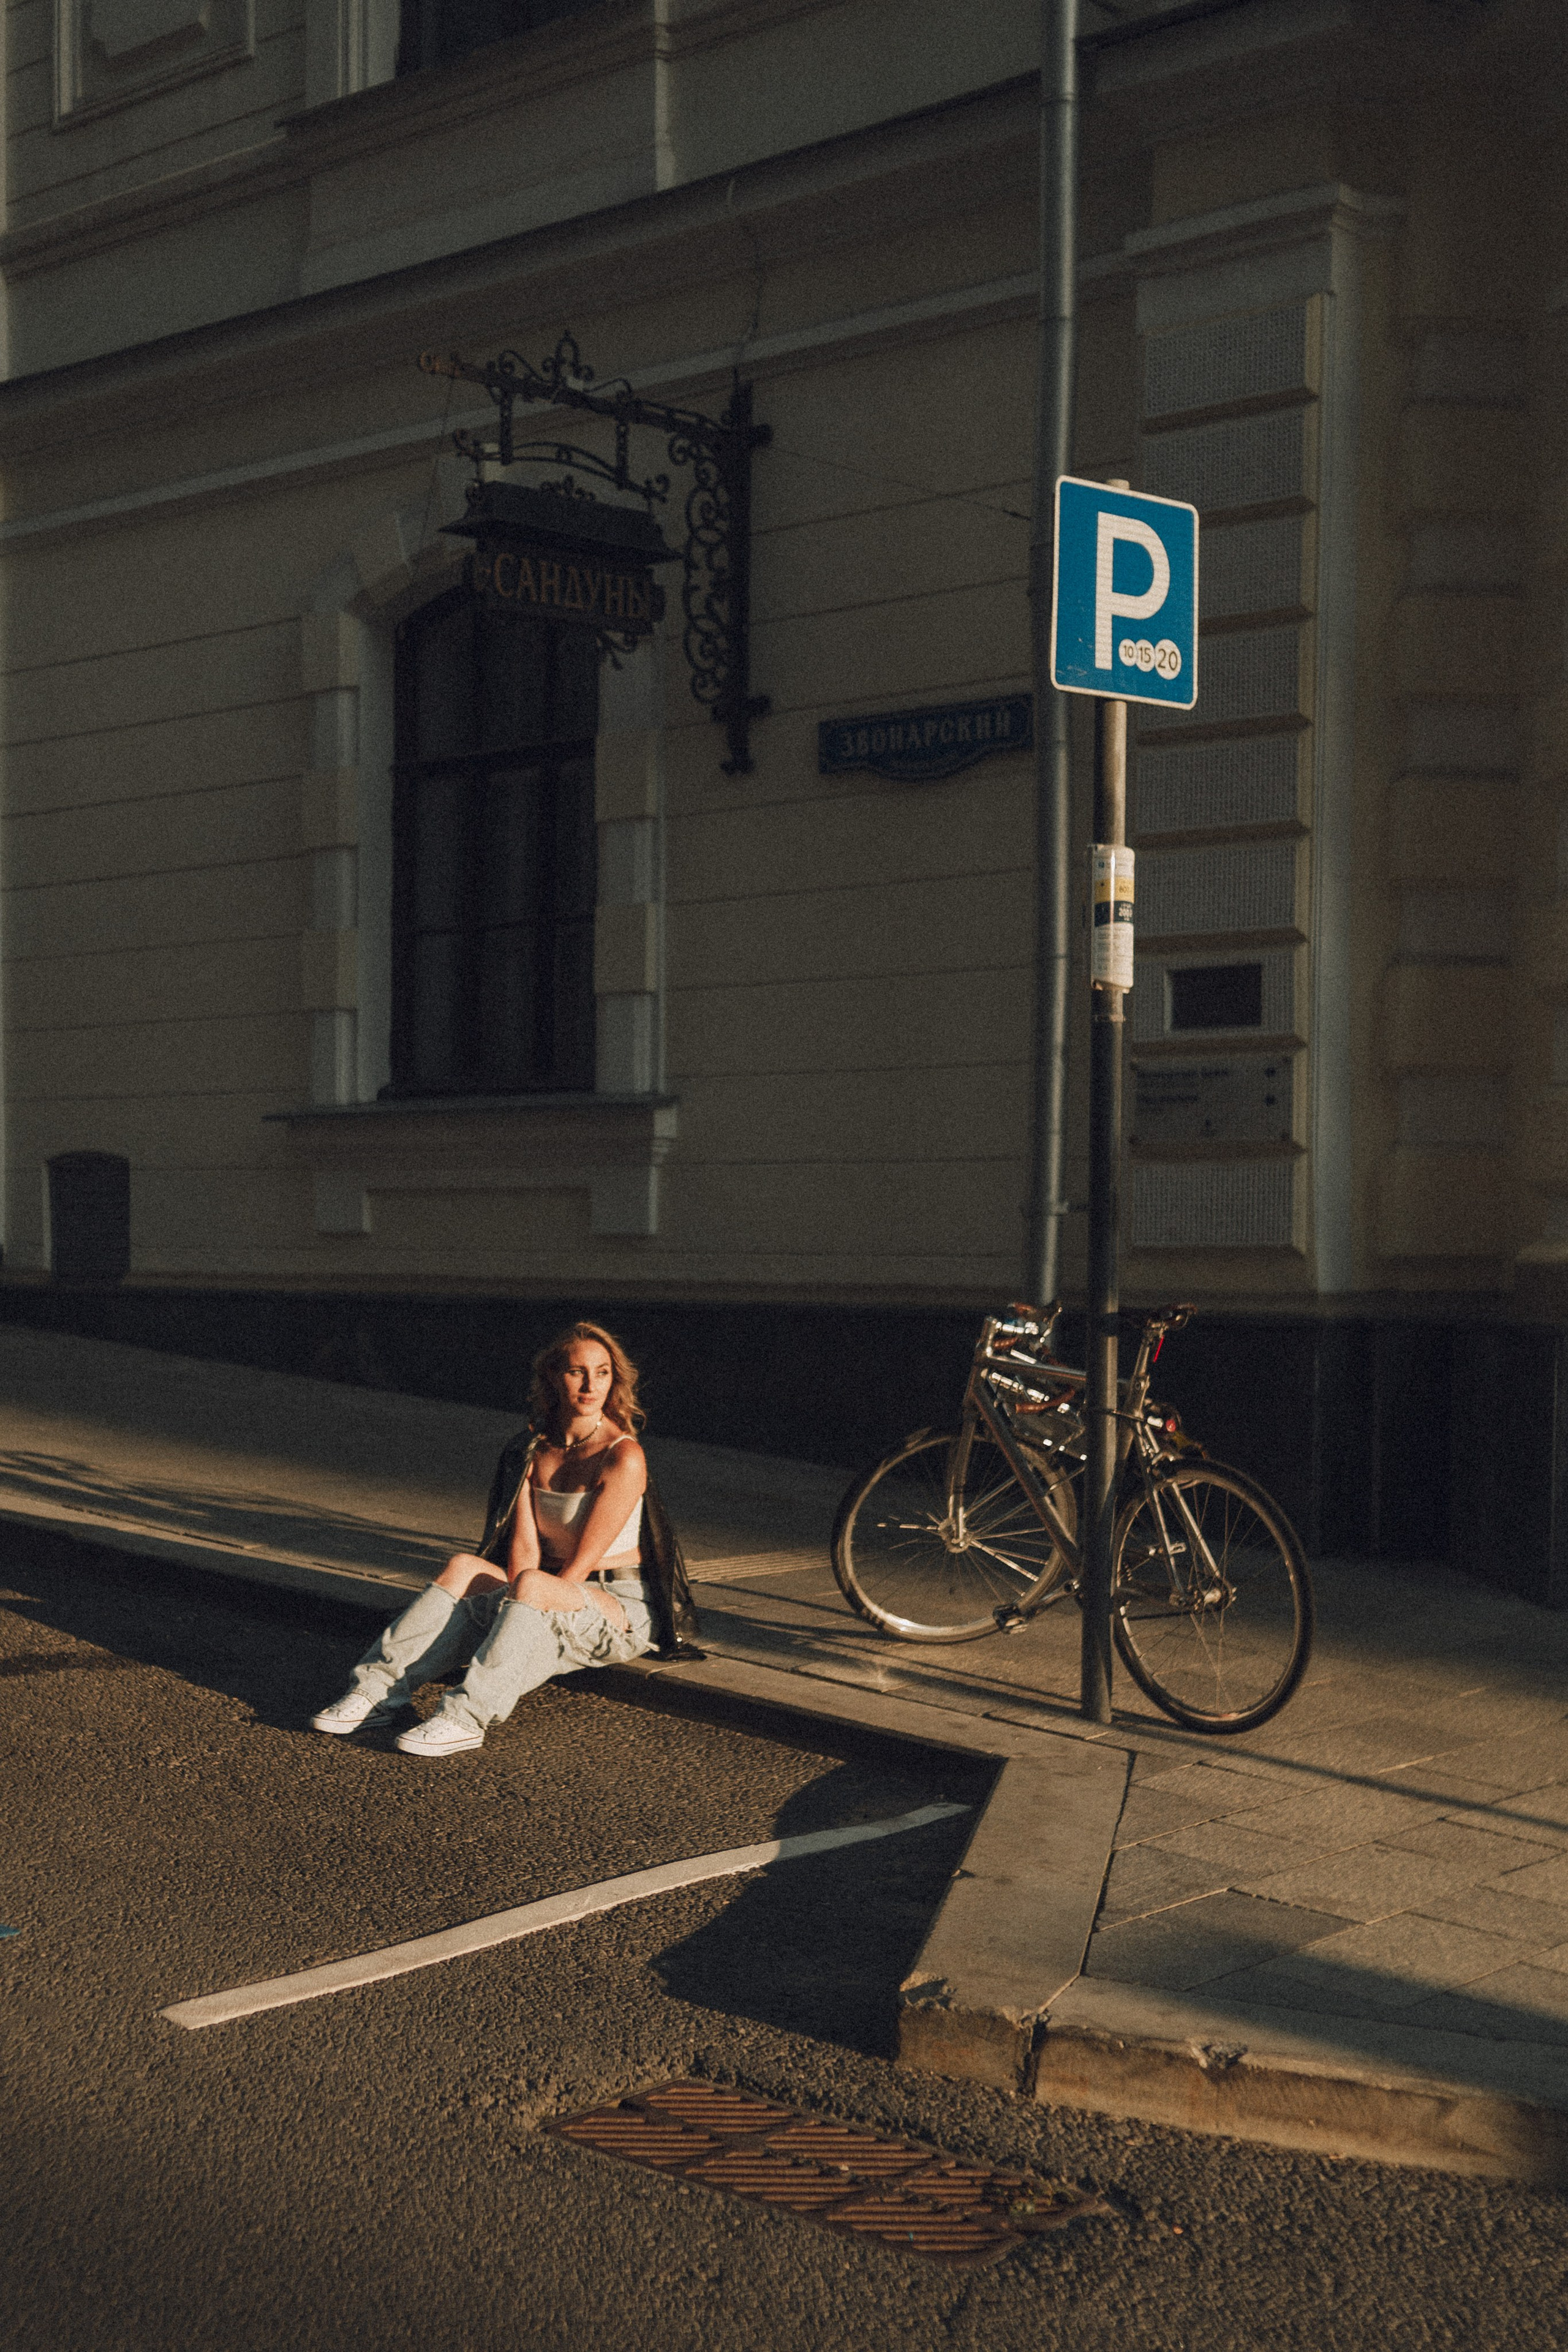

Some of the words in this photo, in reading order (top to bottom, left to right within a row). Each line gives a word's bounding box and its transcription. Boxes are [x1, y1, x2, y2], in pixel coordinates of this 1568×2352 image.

[493, 552, 650, 620] САНДУНЫ
[1095, 511, 1170, 671] P
[1123, 644, 1134, 658] 10
[1139, 646, 1152, 664] 15
[1157, 648, 1178, 671] 20
[840, 706, 1012, 758] ЗВОНАРСКИЙ
